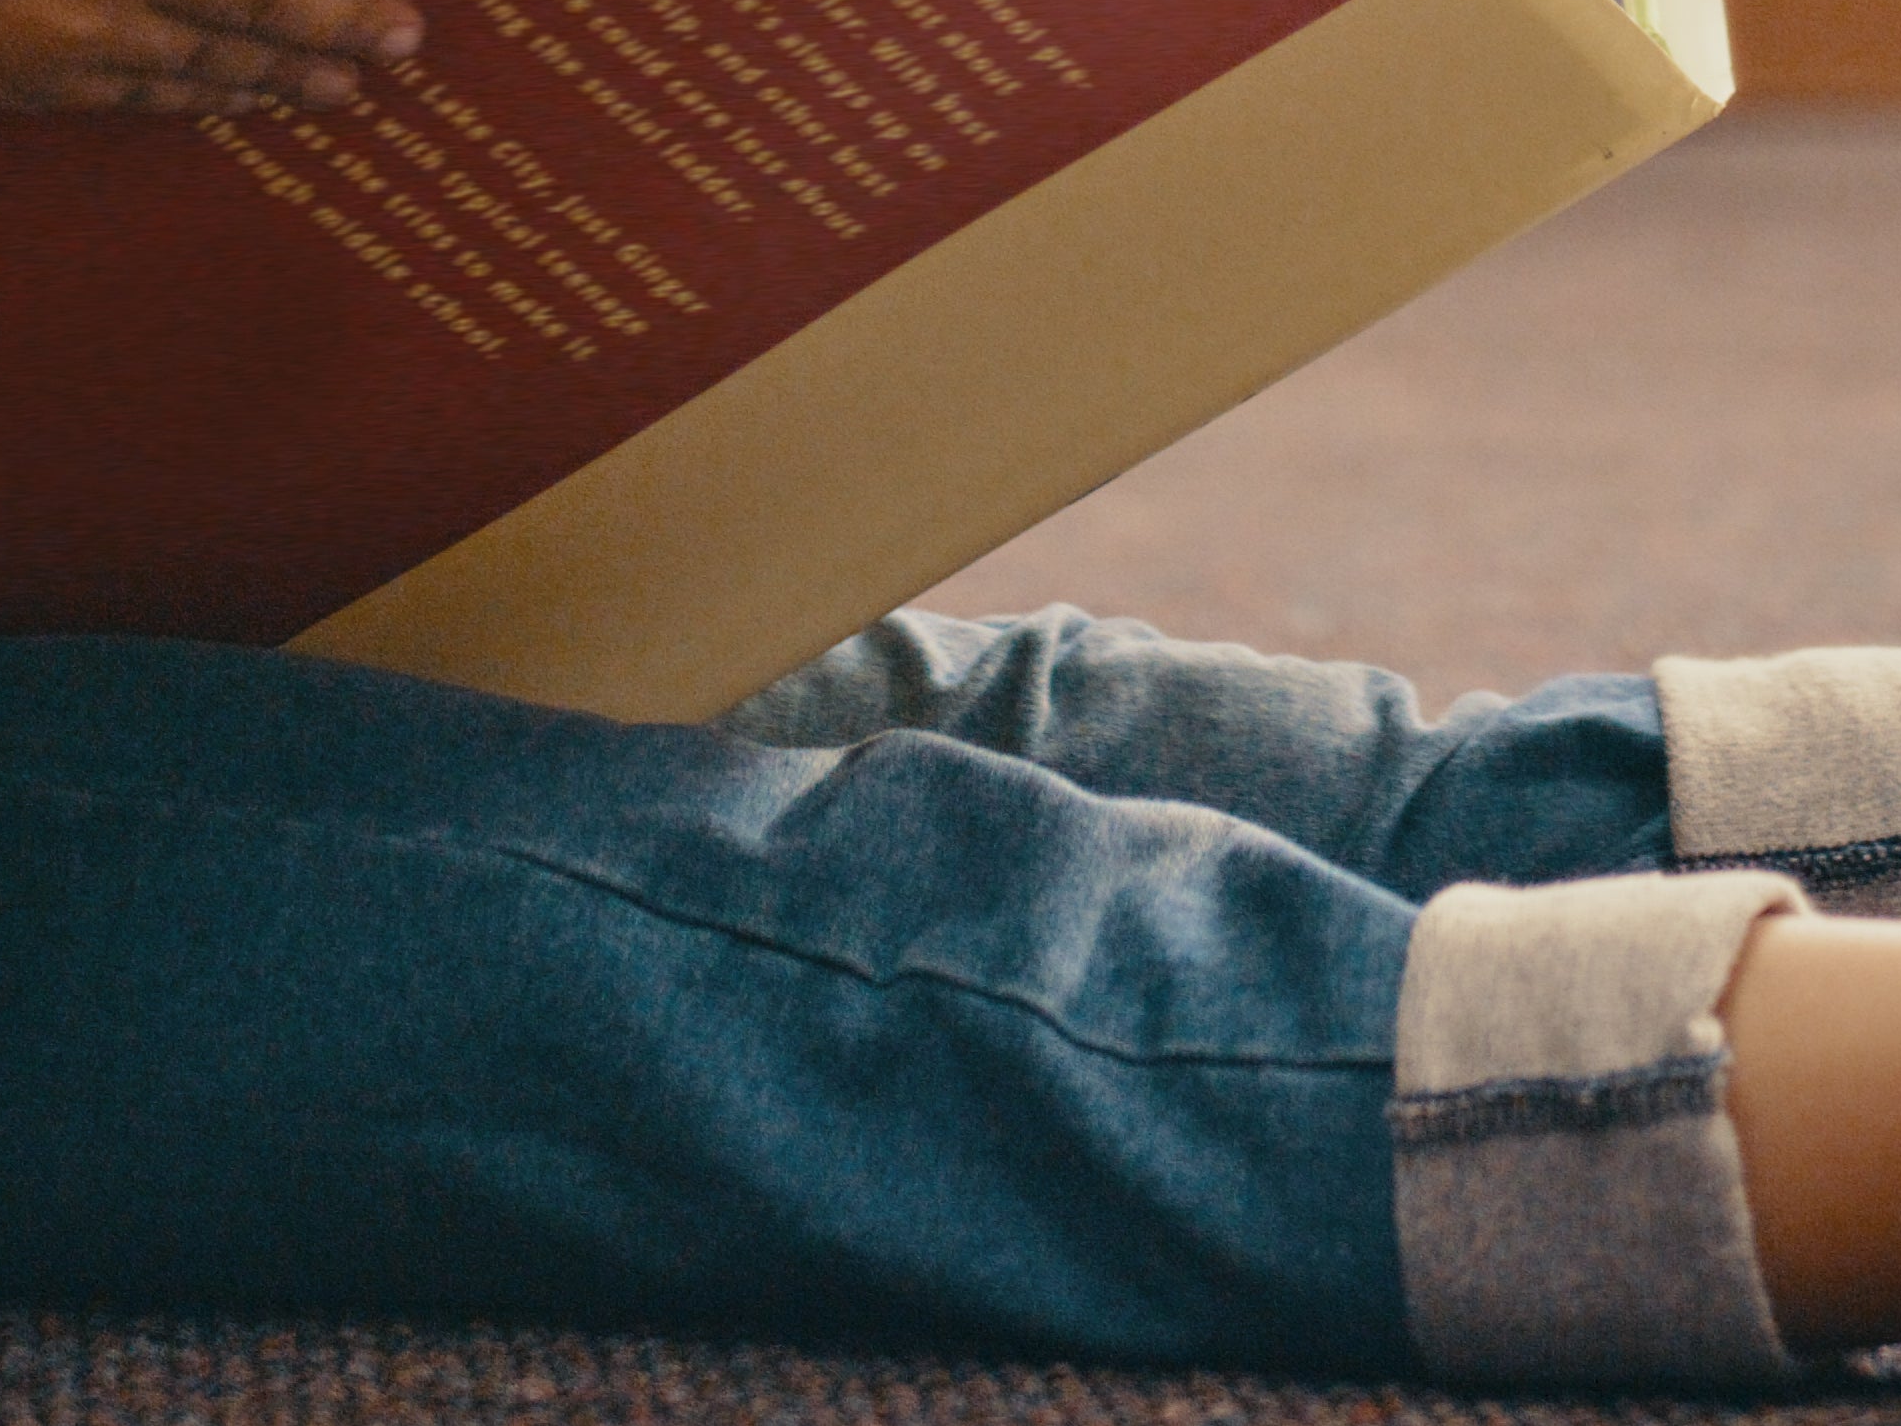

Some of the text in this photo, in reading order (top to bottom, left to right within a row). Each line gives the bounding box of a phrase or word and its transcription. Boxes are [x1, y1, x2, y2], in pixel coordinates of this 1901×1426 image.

[527, 33, 585, 77] the
[577, 76, 674, 145] social
[586, 14, 678, 79] could
[663, 78, 733, 130] care
[722, 125, 790, 176] less
[778, 177, 868, 240] about
[701, 41, 770, 85] and
[754, 85, 839, 146] other
[828, 143, 899, 198] best
[774, 32, 876, 110] always
[864, 108, 913, 143] up
[901, 140, 949, 174] on
[868, 36, 940, 95] With
[929, 91, 1001, 146] best
[935, 30, 1025, 97] about
[195, 105, 316, 206] through
[309, 205, 413, 282] middle
[289, 121, 600, 363] as she tries to make it
[372, 116, 650, 336] with typical teenage
[417, 82, 495, 142] Lake
[614, 241, 711, 314] Ginger
